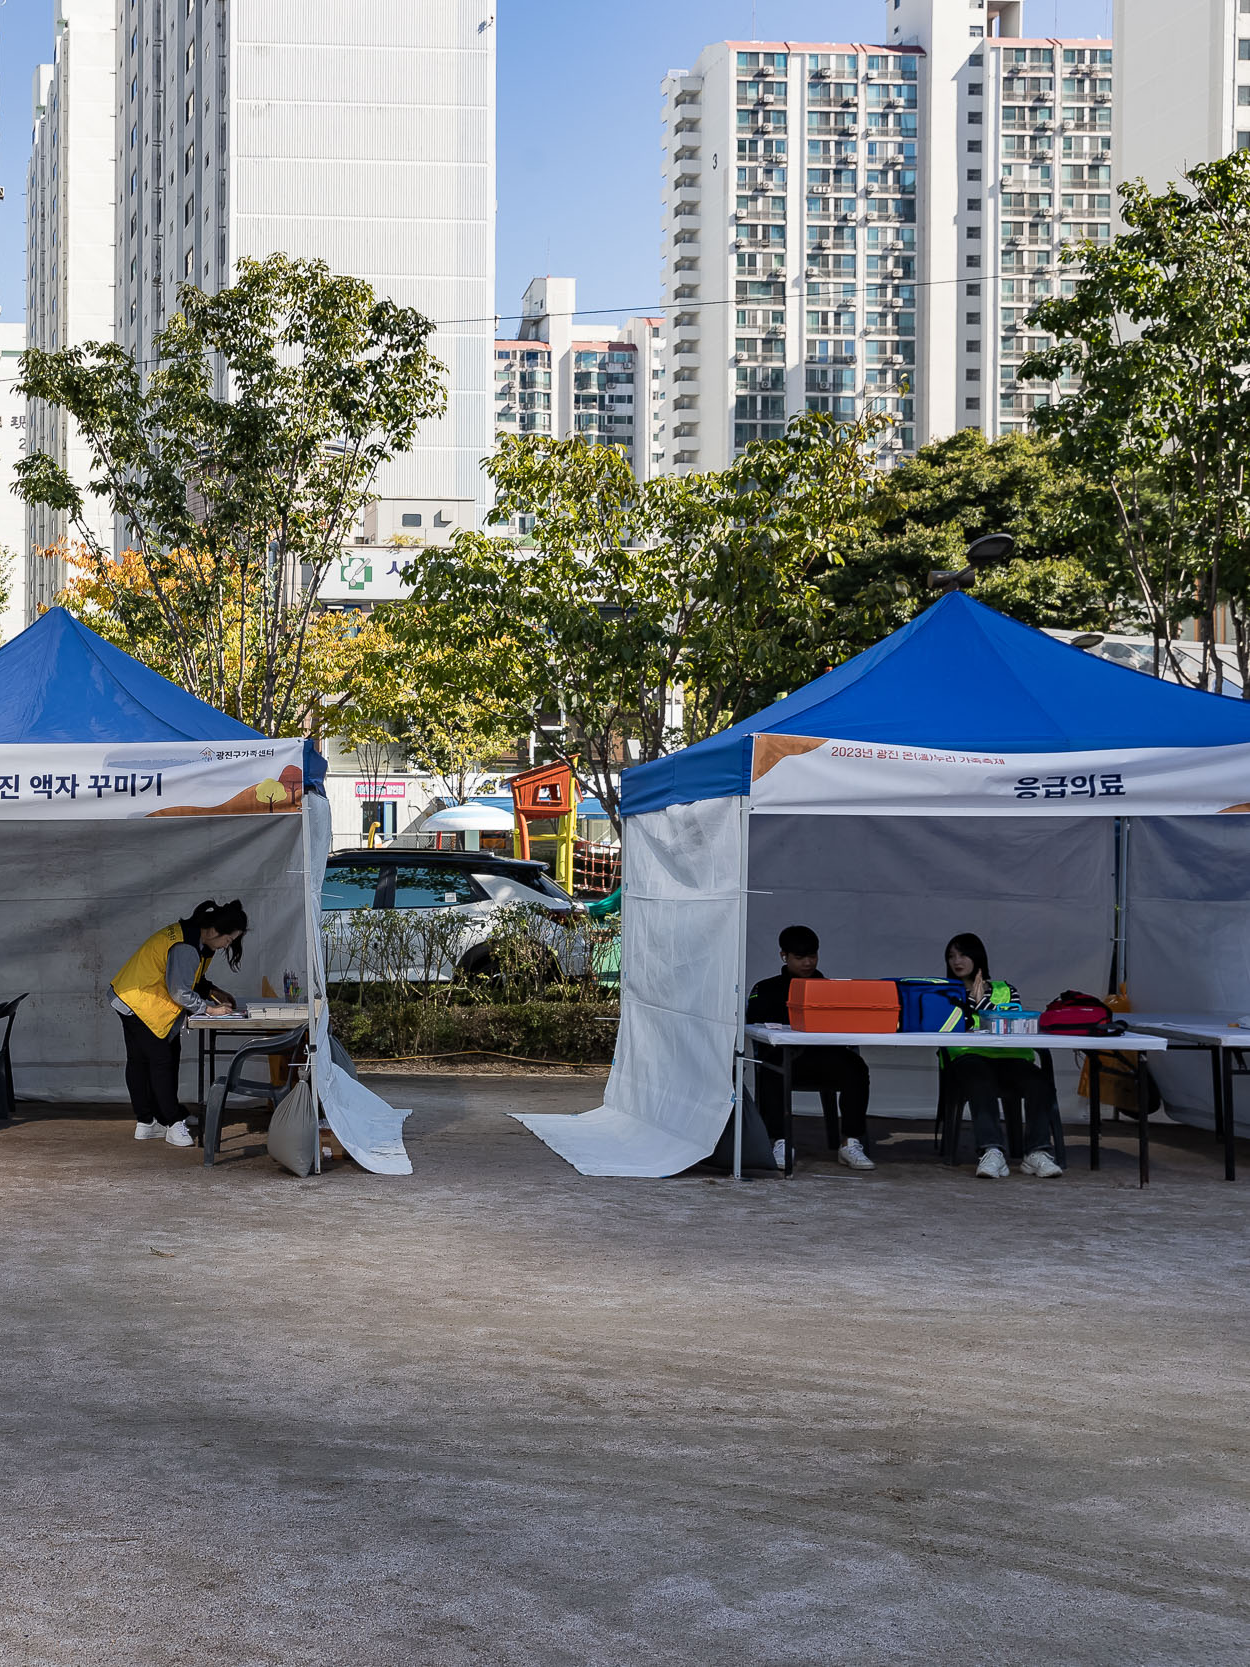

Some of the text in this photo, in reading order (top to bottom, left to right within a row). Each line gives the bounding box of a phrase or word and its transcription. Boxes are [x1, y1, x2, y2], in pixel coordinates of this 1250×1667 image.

[712, 153, 718, 170] 3
[216, 748, 274, 761] 광진구가족센터
[831, 746, 873, 759] 2023년
[877, 749, 899, 760] 광진
[29, 773, 80, 800] 액자
[88, 772, 163, 799] 꾸미기
[1014, 773, 1126, 799] 응급의료
